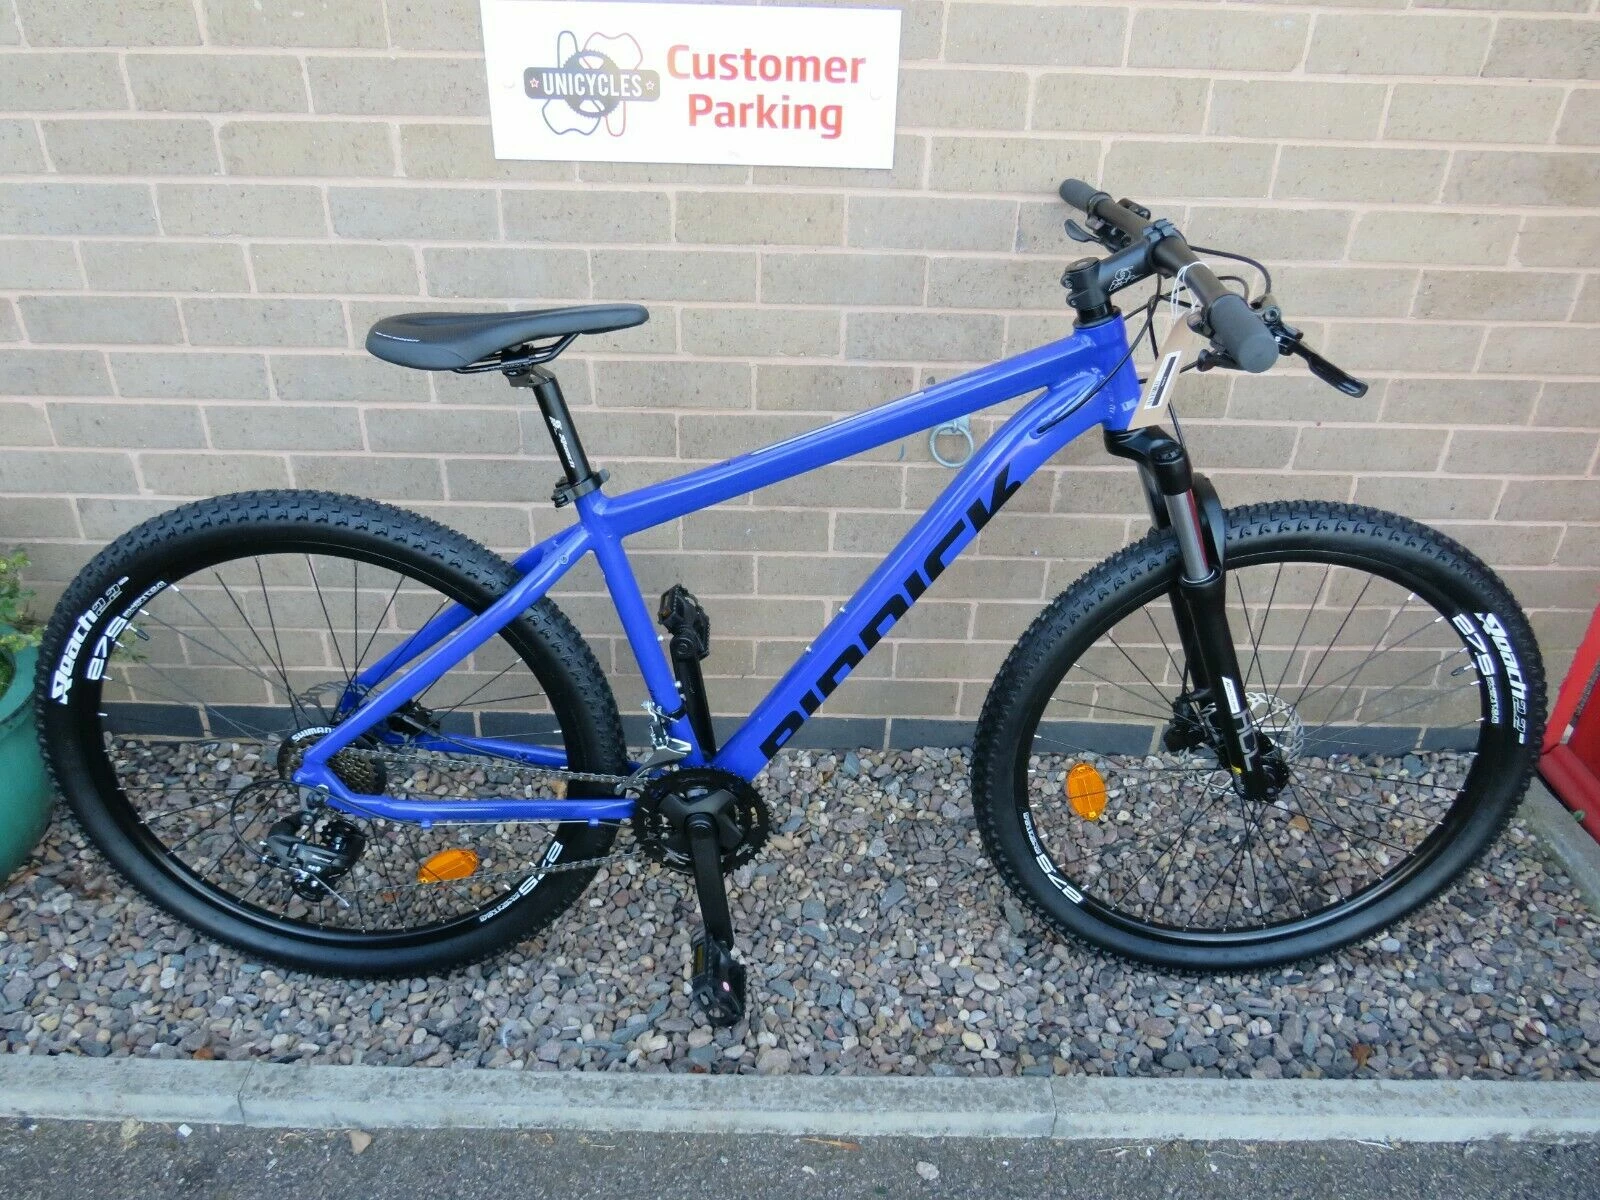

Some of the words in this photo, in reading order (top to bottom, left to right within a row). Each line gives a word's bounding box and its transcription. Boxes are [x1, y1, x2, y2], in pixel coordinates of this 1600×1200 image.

[542, 72, 642, 97] UNICYCLES
[667, 44, 866, 83] Customer
[689, 94, 842, 139] Parking
[87, 616, 128, 680] 27.5
[1452, 613, 1495, 675] 27.5
[292, 727, 336, 742] SHIMAN
[1036, 854, 1083, 904] 27.5
